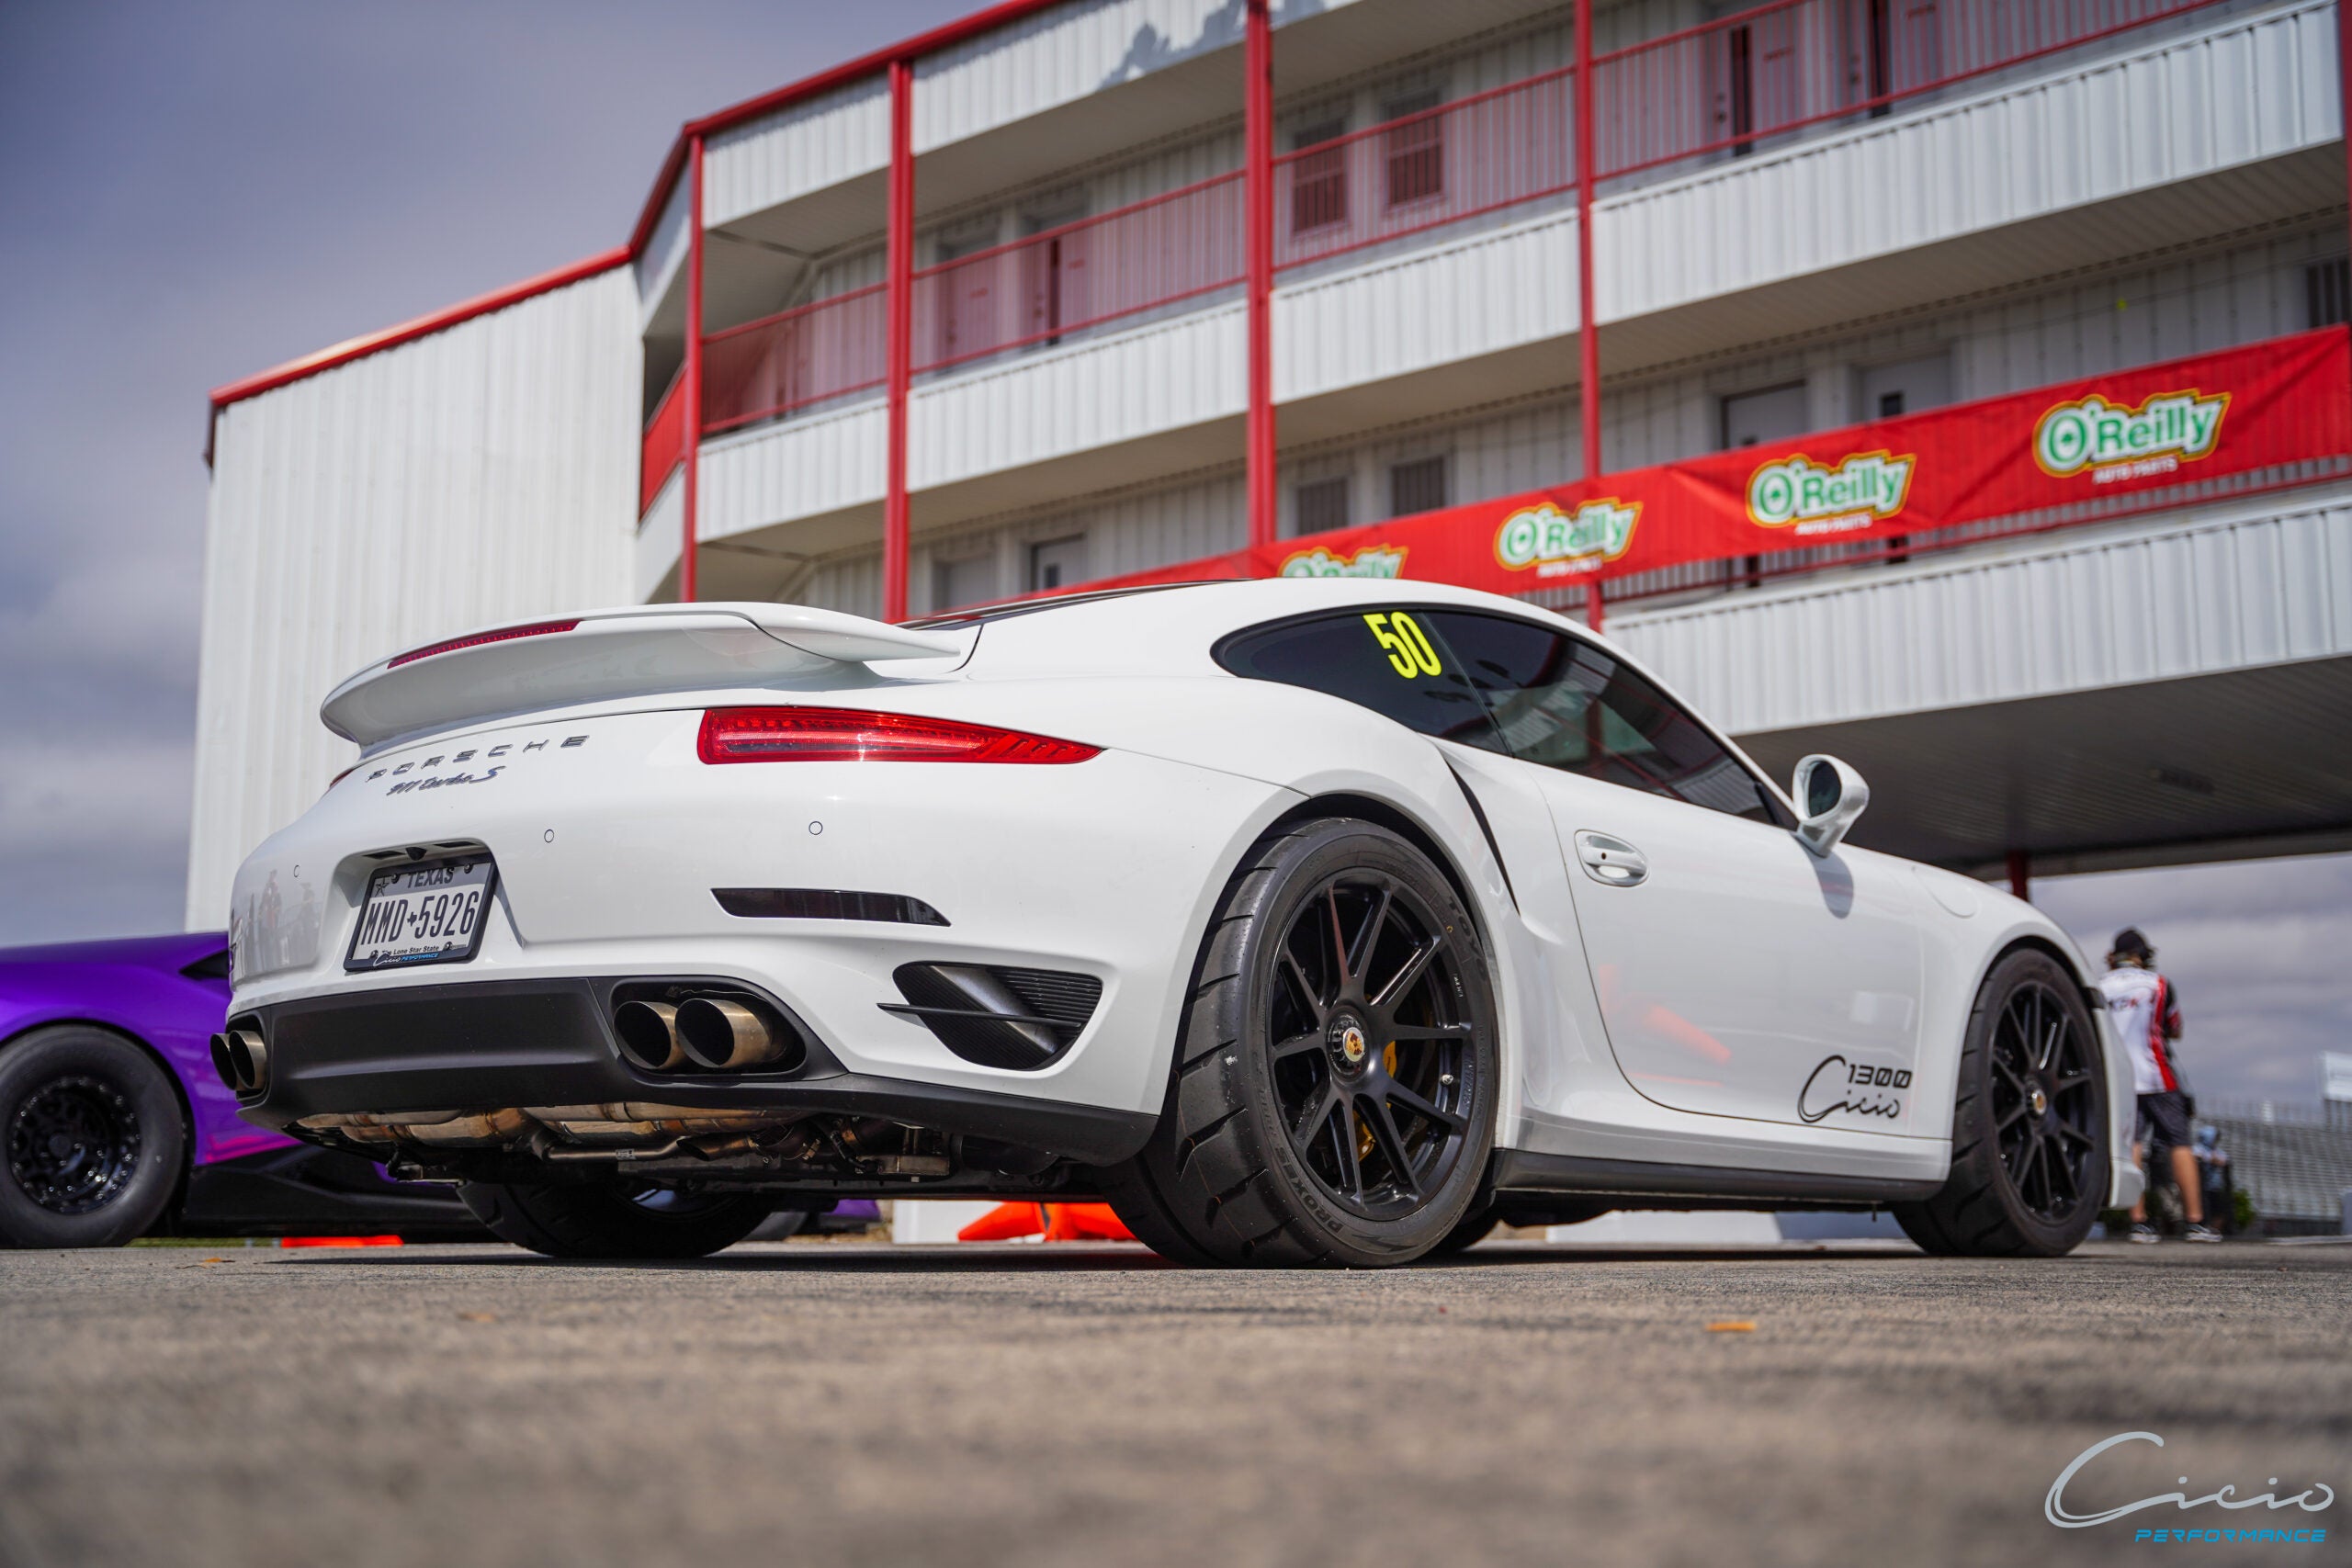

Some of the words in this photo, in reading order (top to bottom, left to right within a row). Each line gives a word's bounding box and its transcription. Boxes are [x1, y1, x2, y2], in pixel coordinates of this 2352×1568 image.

[2048, 405, 2213, 463] O'Reilly
[1758, 465, 1901, 516] O'Reilly
[1363, 611, 1442, 679] 50
[366, 735, 590, 782] PORSCHE
[386, 779, 422, 796] 911
[469, 765, 506, 784] S
[407, 866, 455, 889] TEXAS
[1797, 1055, 1901, 1123] Cicio
[1848, 1064, 1912, 1089] 1300
